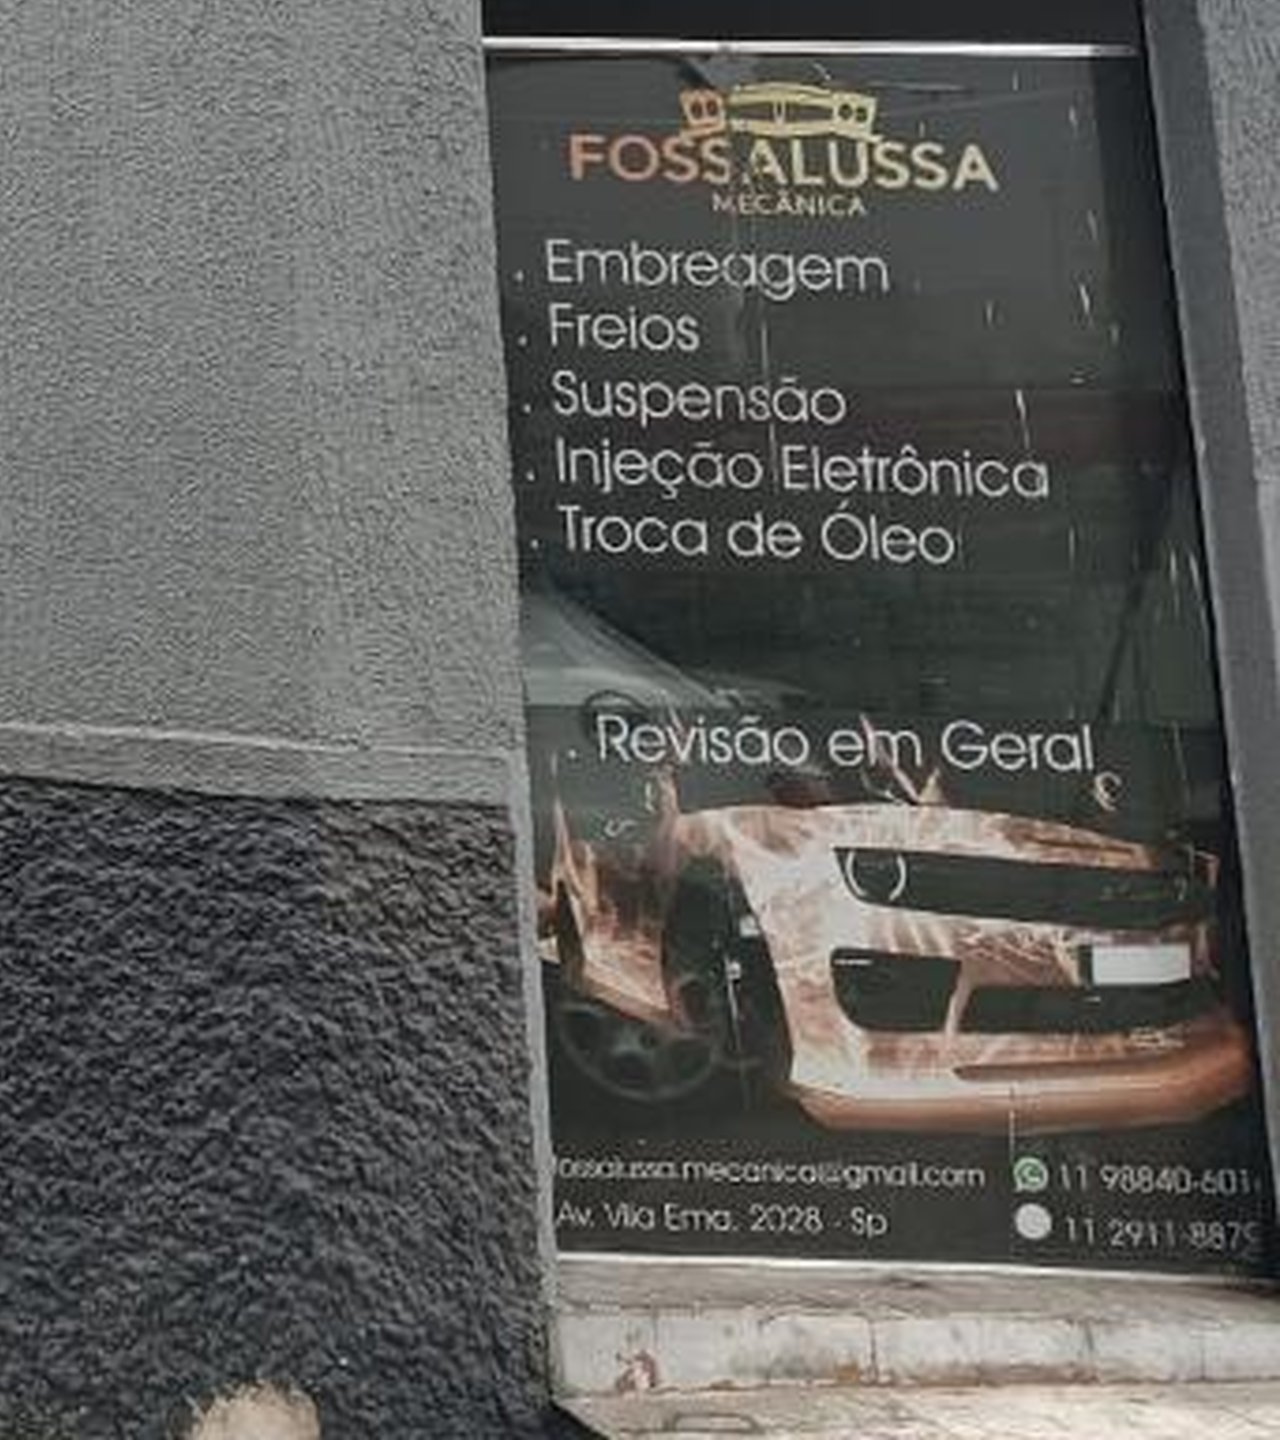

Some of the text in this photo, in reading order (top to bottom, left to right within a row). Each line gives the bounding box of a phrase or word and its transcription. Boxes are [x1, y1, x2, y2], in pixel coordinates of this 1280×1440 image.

[546, 239, 890, 301] Embreagem
[548, 303, 700, 351] Freios
[552, 369, 847, 426] Suspensão
[555, 437, 1051, 498] Injeção Eletrônica
[558, 501, 956, 563] Troca de Óleo
[596, 714, 1096, 773] Revisão em Geral
[1060, 1163, 1087, 1192] 11
[602, 1201, 655, 1231] Vila
[748, 1203, 824, 1235] 2028
[850, 1205, 888, 1239] Sp
[1066, 1216, 1095, 1244] 11
